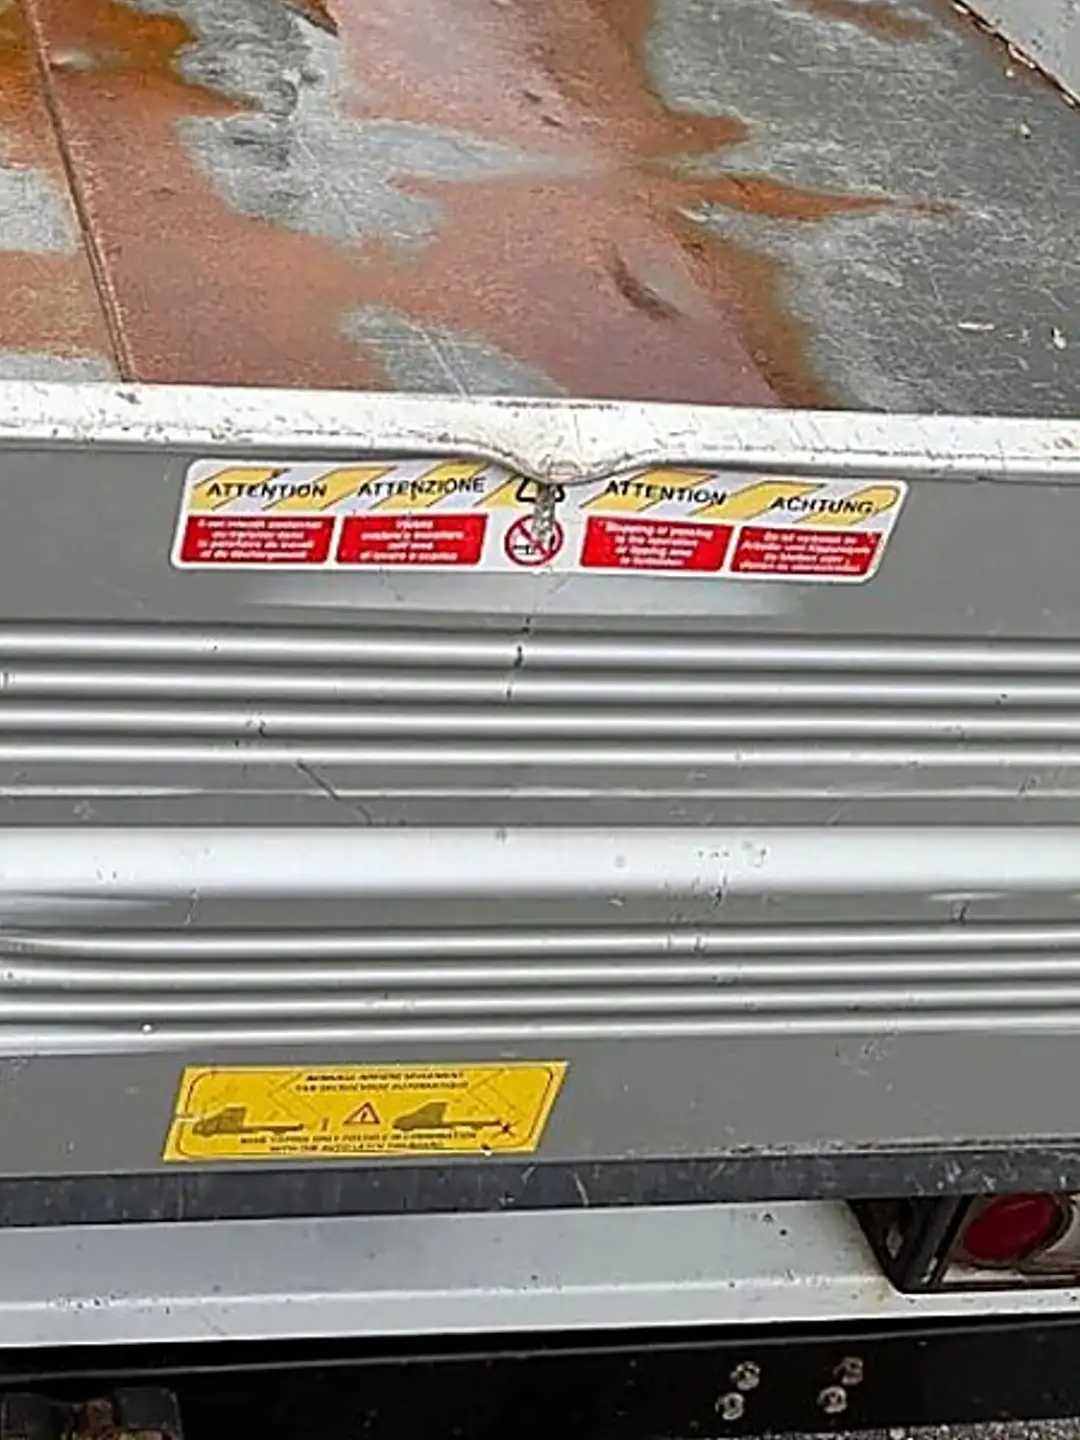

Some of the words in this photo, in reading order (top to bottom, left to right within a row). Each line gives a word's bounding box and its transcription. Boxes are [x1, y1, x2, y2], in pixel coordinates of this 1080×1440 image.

[206, 482, 328, 499] ATTENTION
[358, 476, 487, 497] ATTENZIONE
[605, 480, 727, 506] ATTENTION
[770, 496, 874, 513] ACHTUNG
